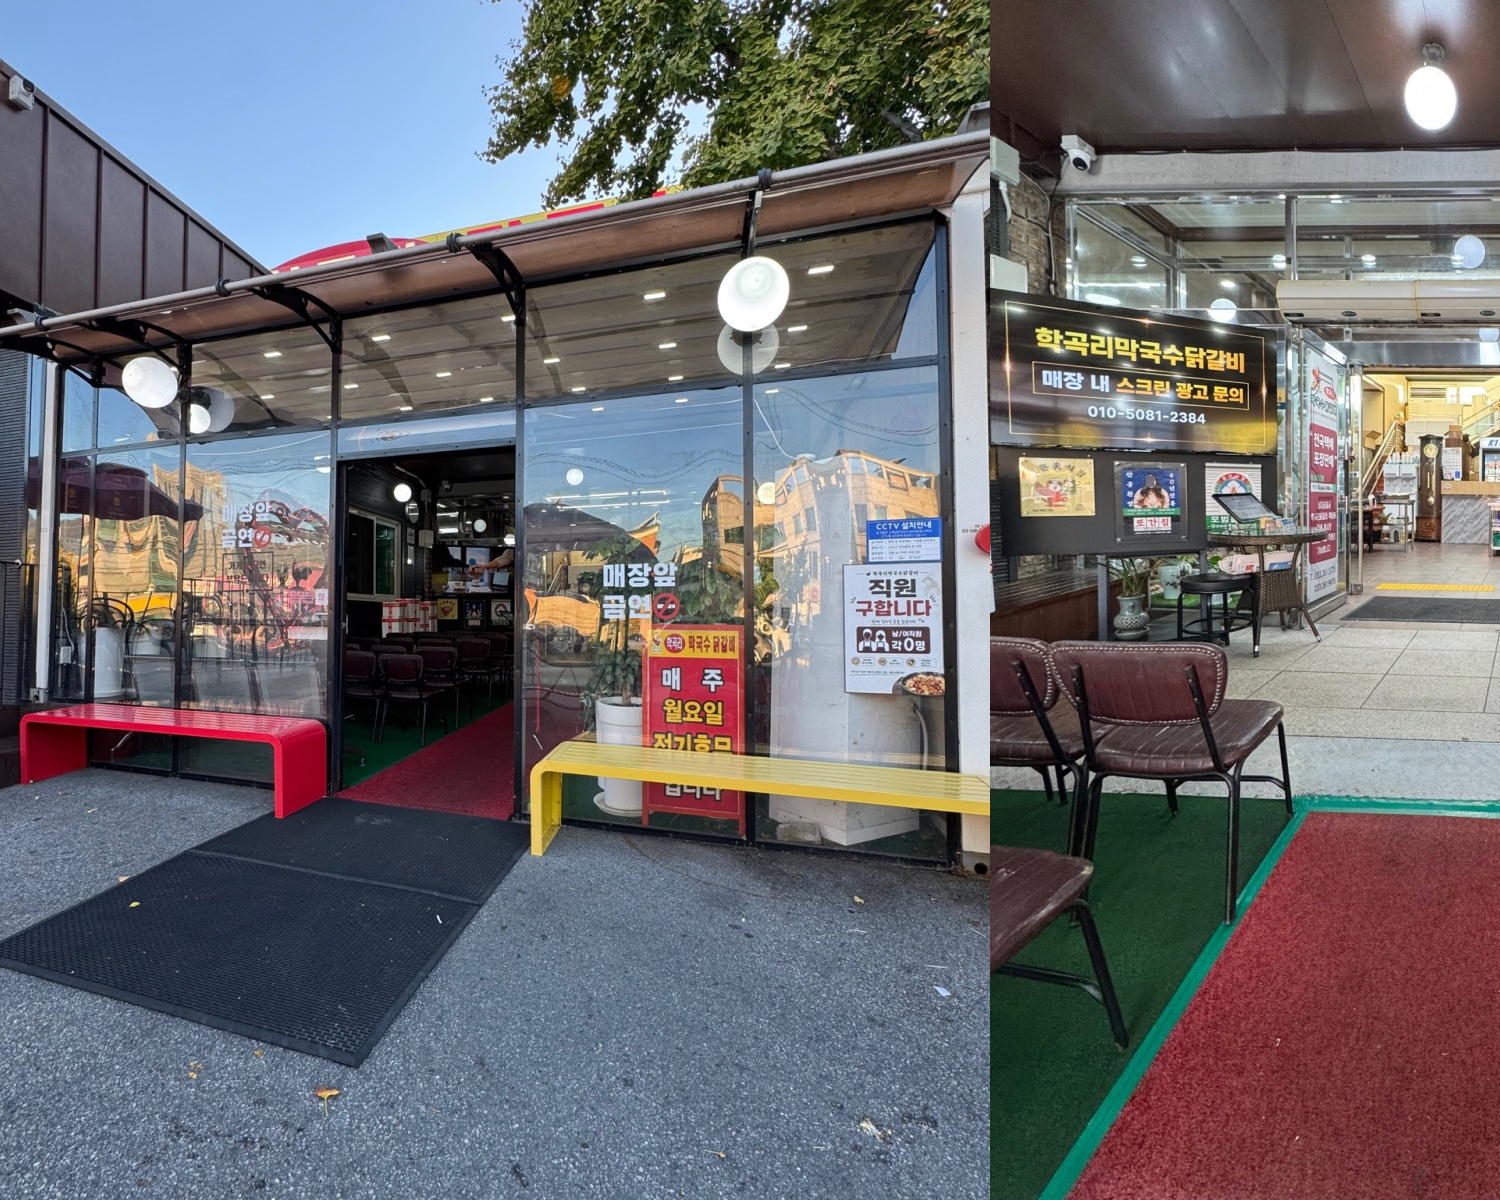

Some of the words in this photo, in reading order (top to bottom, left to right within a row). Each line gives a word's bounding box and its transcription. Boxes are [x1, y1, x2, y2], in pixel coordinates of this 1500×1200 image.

[1034, 327, 1245, 373] 학곡리막국수닭갈비
[1042, 370, 1083, 391] 매장
[1091, 375, 1110, 393] 내
[1116, 377, 1171, 398] 스크린
[1176, 382, 1209, 401] 광고
[1212, 387, 1244, 403] 문의
[1088, 405, 1206, 424] 010-5081-2384
[222, 501, 272, 522] 매장앞
[1135, 517, 1169, 527] 또간집
[876, 522, 899, 530] CCTV
[901, 520, 932, 529] 설치안내
[222, 527, 254, 548] 금연
[603, 562, 678, 587] 매장앞
[868, 578, 917, 598] 직원
[602, 595, 651, 619] 금연
[856, 599, 932, 616] 구합니다
[666, 636, 683, 650] 학곡리
[688, 635, 711, 653] 막국수
[712, 635, 736, 654] 닭갈비
[662, 698, 724, 726] 월요일
